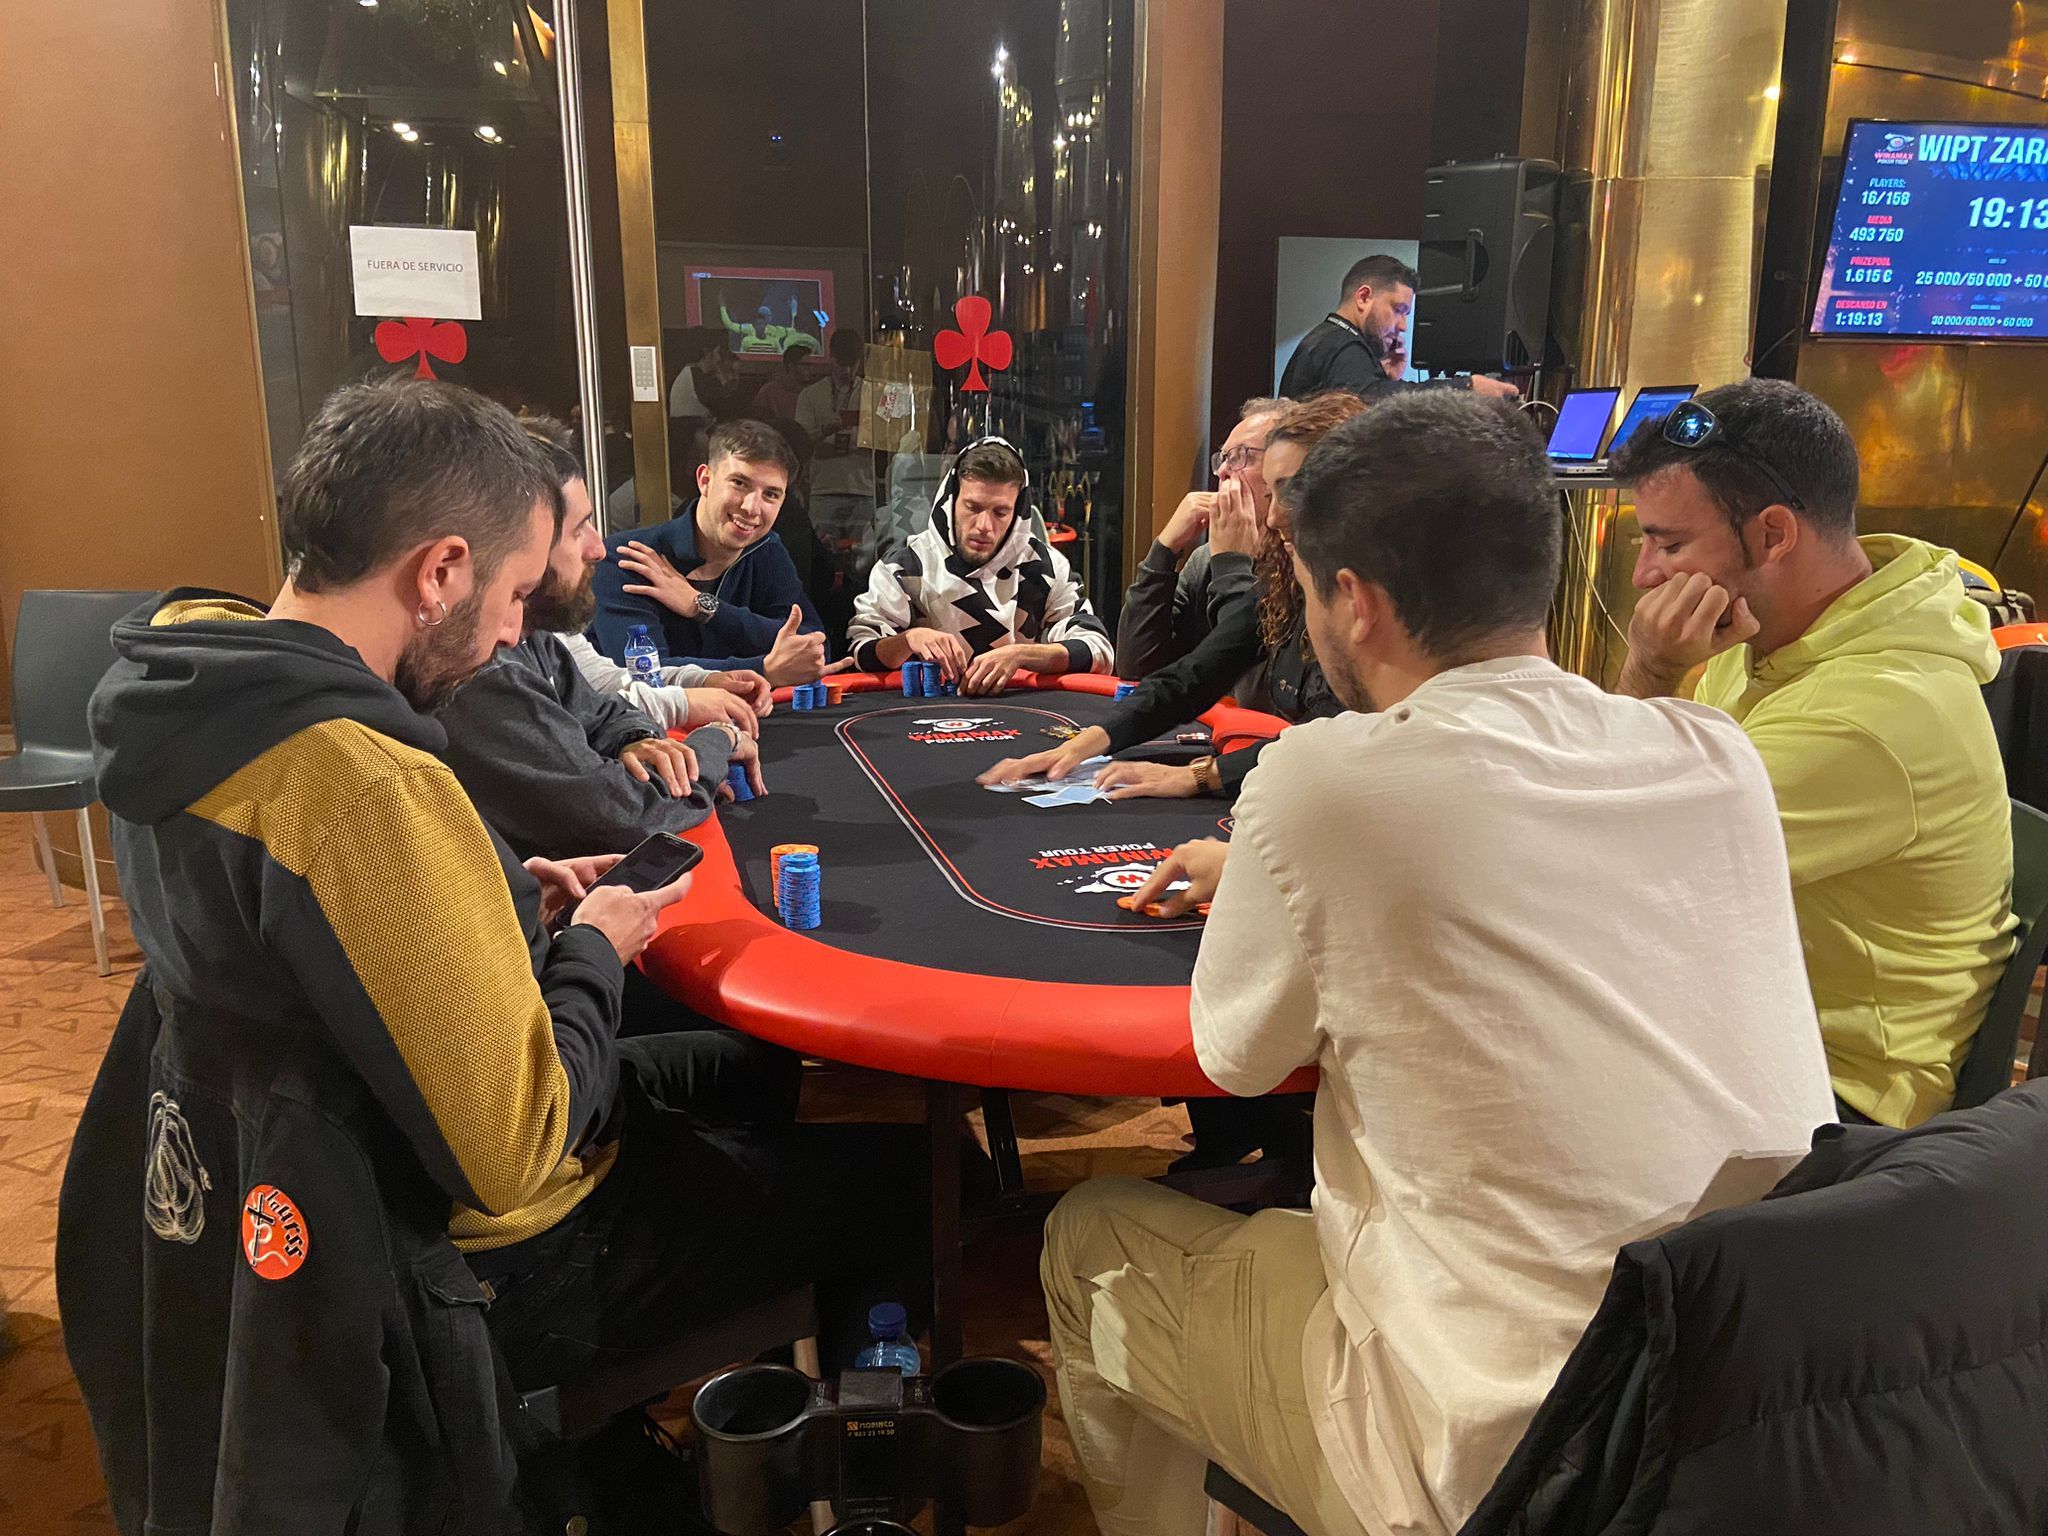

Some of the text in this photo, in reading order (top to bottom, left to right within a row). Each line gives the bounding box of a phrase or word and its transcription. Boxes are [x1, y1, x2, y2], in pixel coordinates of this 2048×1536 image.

[1874, 152, 1914, 160] WINAMAX
[1918, 135, 1988, 162] WIPT
[1869, 178, 1906, 188] PLAYERS:
[1861, 190, 1910, 206] 16/158
[1969, 197, 2048, 229] 19:13
[1849, 227, 1904, 242] 493 750
[367, 260, 464, 273] FUERA DE SERVICIO
[1845, 268, 1881, 283] 1.615
[1915, 271, 1934, 285] 25
[1986, 272, 2012, 287] 000
[1835, 312, 1883, 326] 1:19:13
[907, 729, 1022, 742] WINAMAX
[924, 737, 976, 745] POKER
[1038, 842, 1156, 858] POKER TOUR
[1028, 847, 1173, 869] WINAMAX
